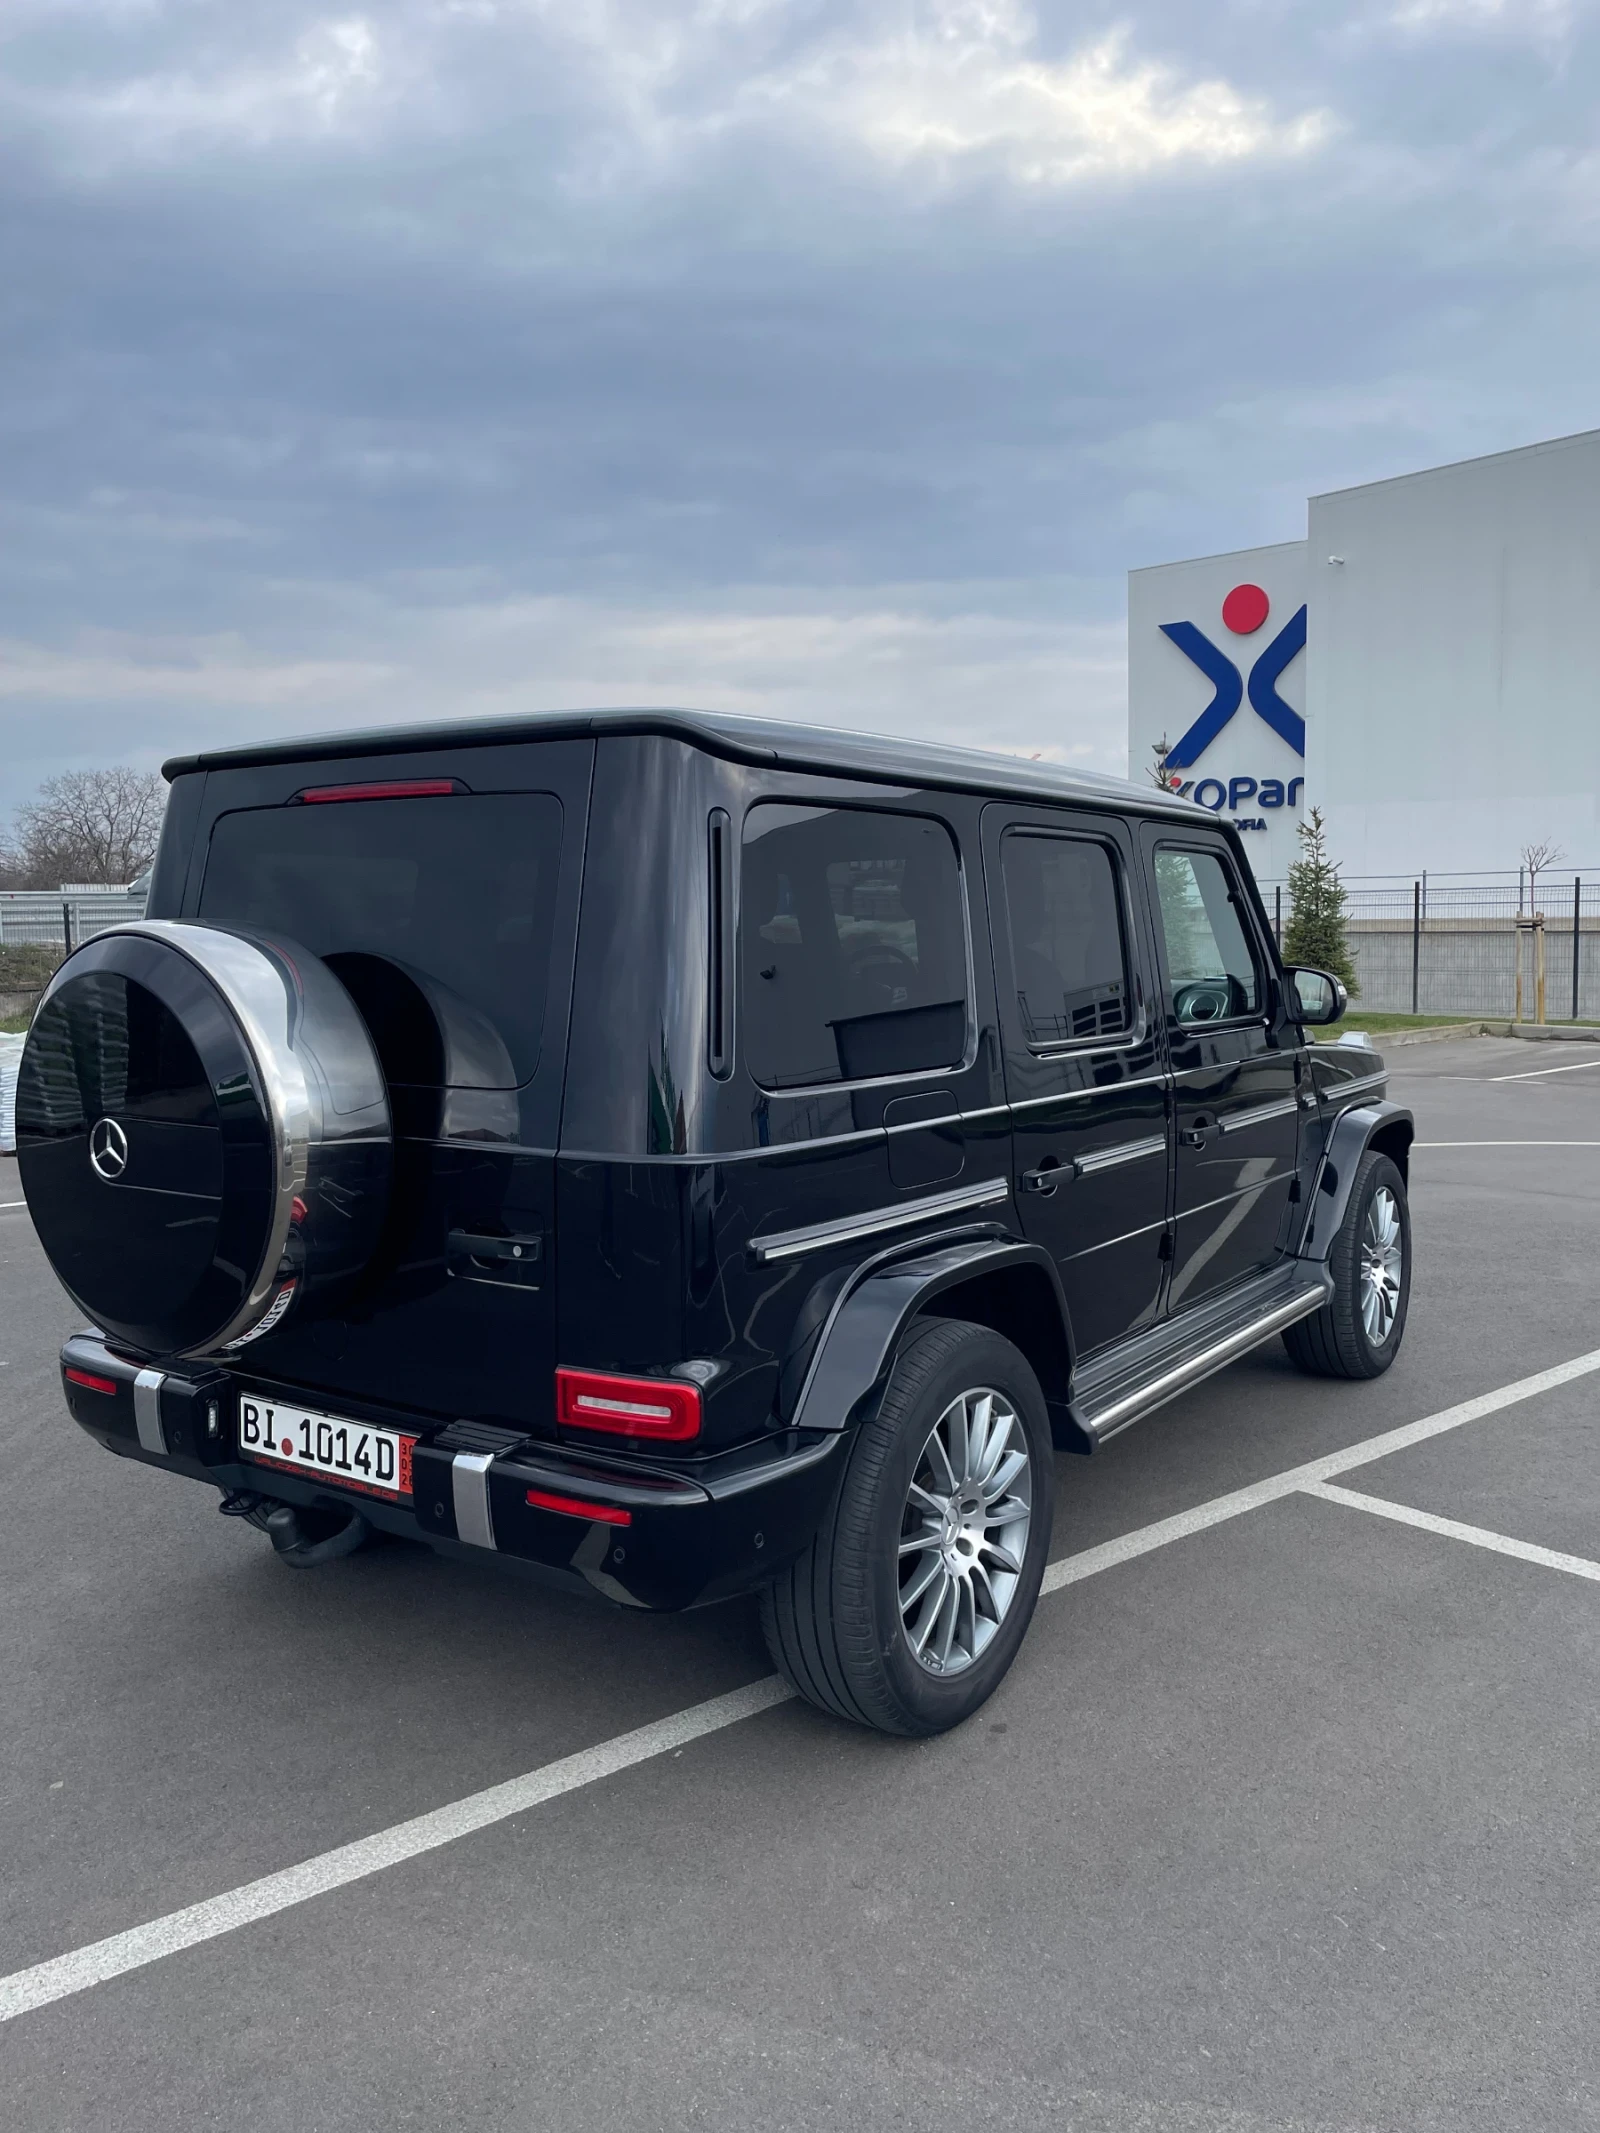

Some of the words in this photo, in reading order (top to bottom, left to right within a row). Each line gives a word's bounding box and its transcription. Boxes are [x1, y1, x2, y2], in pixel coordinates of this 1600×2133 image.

[1233, 818, 1267, 831] OFIA
[243, 1403, 277, 1450] BI
[299, 1419, 395, 1481] 1014D
